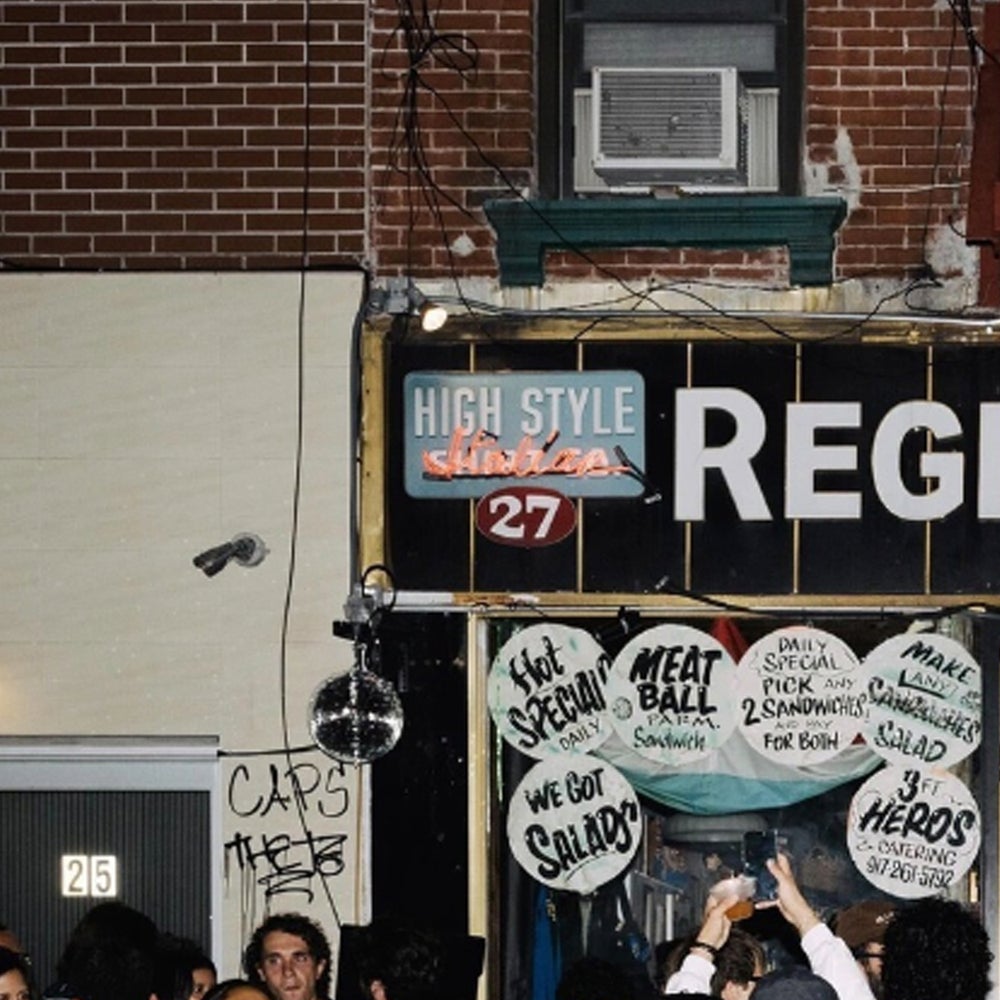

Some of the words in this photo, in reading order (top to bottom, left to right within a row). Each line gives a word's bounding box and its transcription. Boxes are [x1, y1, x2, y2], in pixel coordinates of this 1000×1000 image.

[414, 386, 500, 437] HIGH
[520, 386, 635, 437] STYLE
[489, 495, 562, 539] 27
[762, 652, 841, 673] SPECIAL
[778, 637, 827, 654] DAILY
[900, 641, 977, 686] MAKE
[629, 645, 722, 686] MEAT
[636, 682, 718, 715] BALL
[762, 675, 815, 696] PICK
[741, 697, 761, 726] 2
[763, 732, 794, 751] FOR
[799, 731, 839, 751] BOTH
[228, 763, 350, 817] CAPS
[524, 781, 564, 814] WE
[565, 768, 604, 804] GOT
[897, 770, 921, 803] 3
[524, 798, 638, 880] SALADS
[858, 796, 976, 847] HEROS
[878, 840, 957, 867] CATERING
[67, 858, 114, 894] 25
